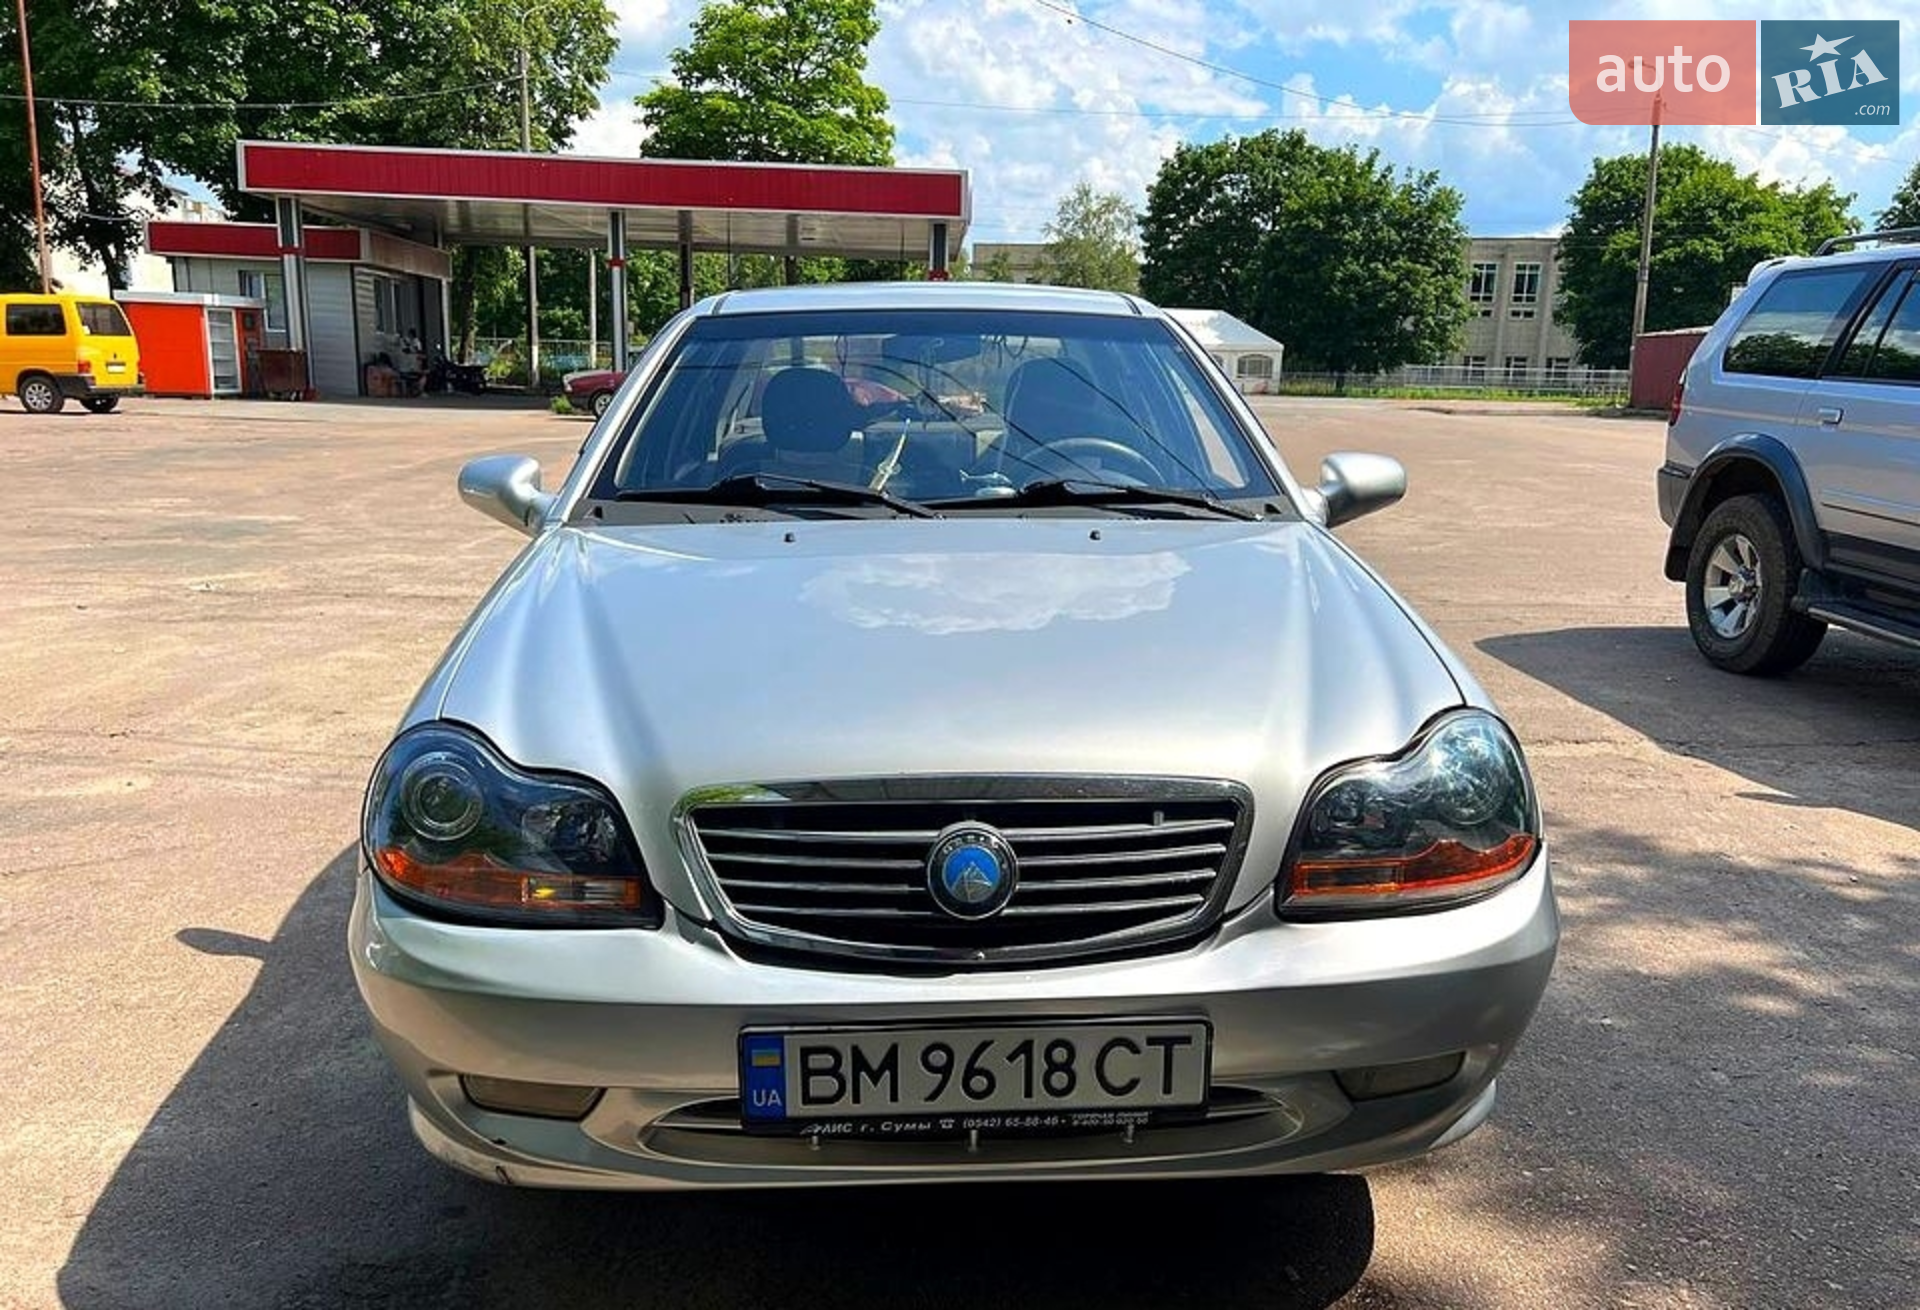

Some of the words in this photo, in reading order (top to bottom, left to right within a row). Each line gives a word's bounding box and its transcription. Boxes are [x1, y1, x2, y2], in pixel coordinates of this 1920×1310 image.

[800, 1043, 898, 1106] BM
[919, 1038, 1077, 1102] 9618
[1095, 1036, 1192, 1098] CT
[752, 1089, 782, 1107] UA
[881, 1121, 932, 1133] Сумы
[963, 1117, 1001, 1129] (0542)
